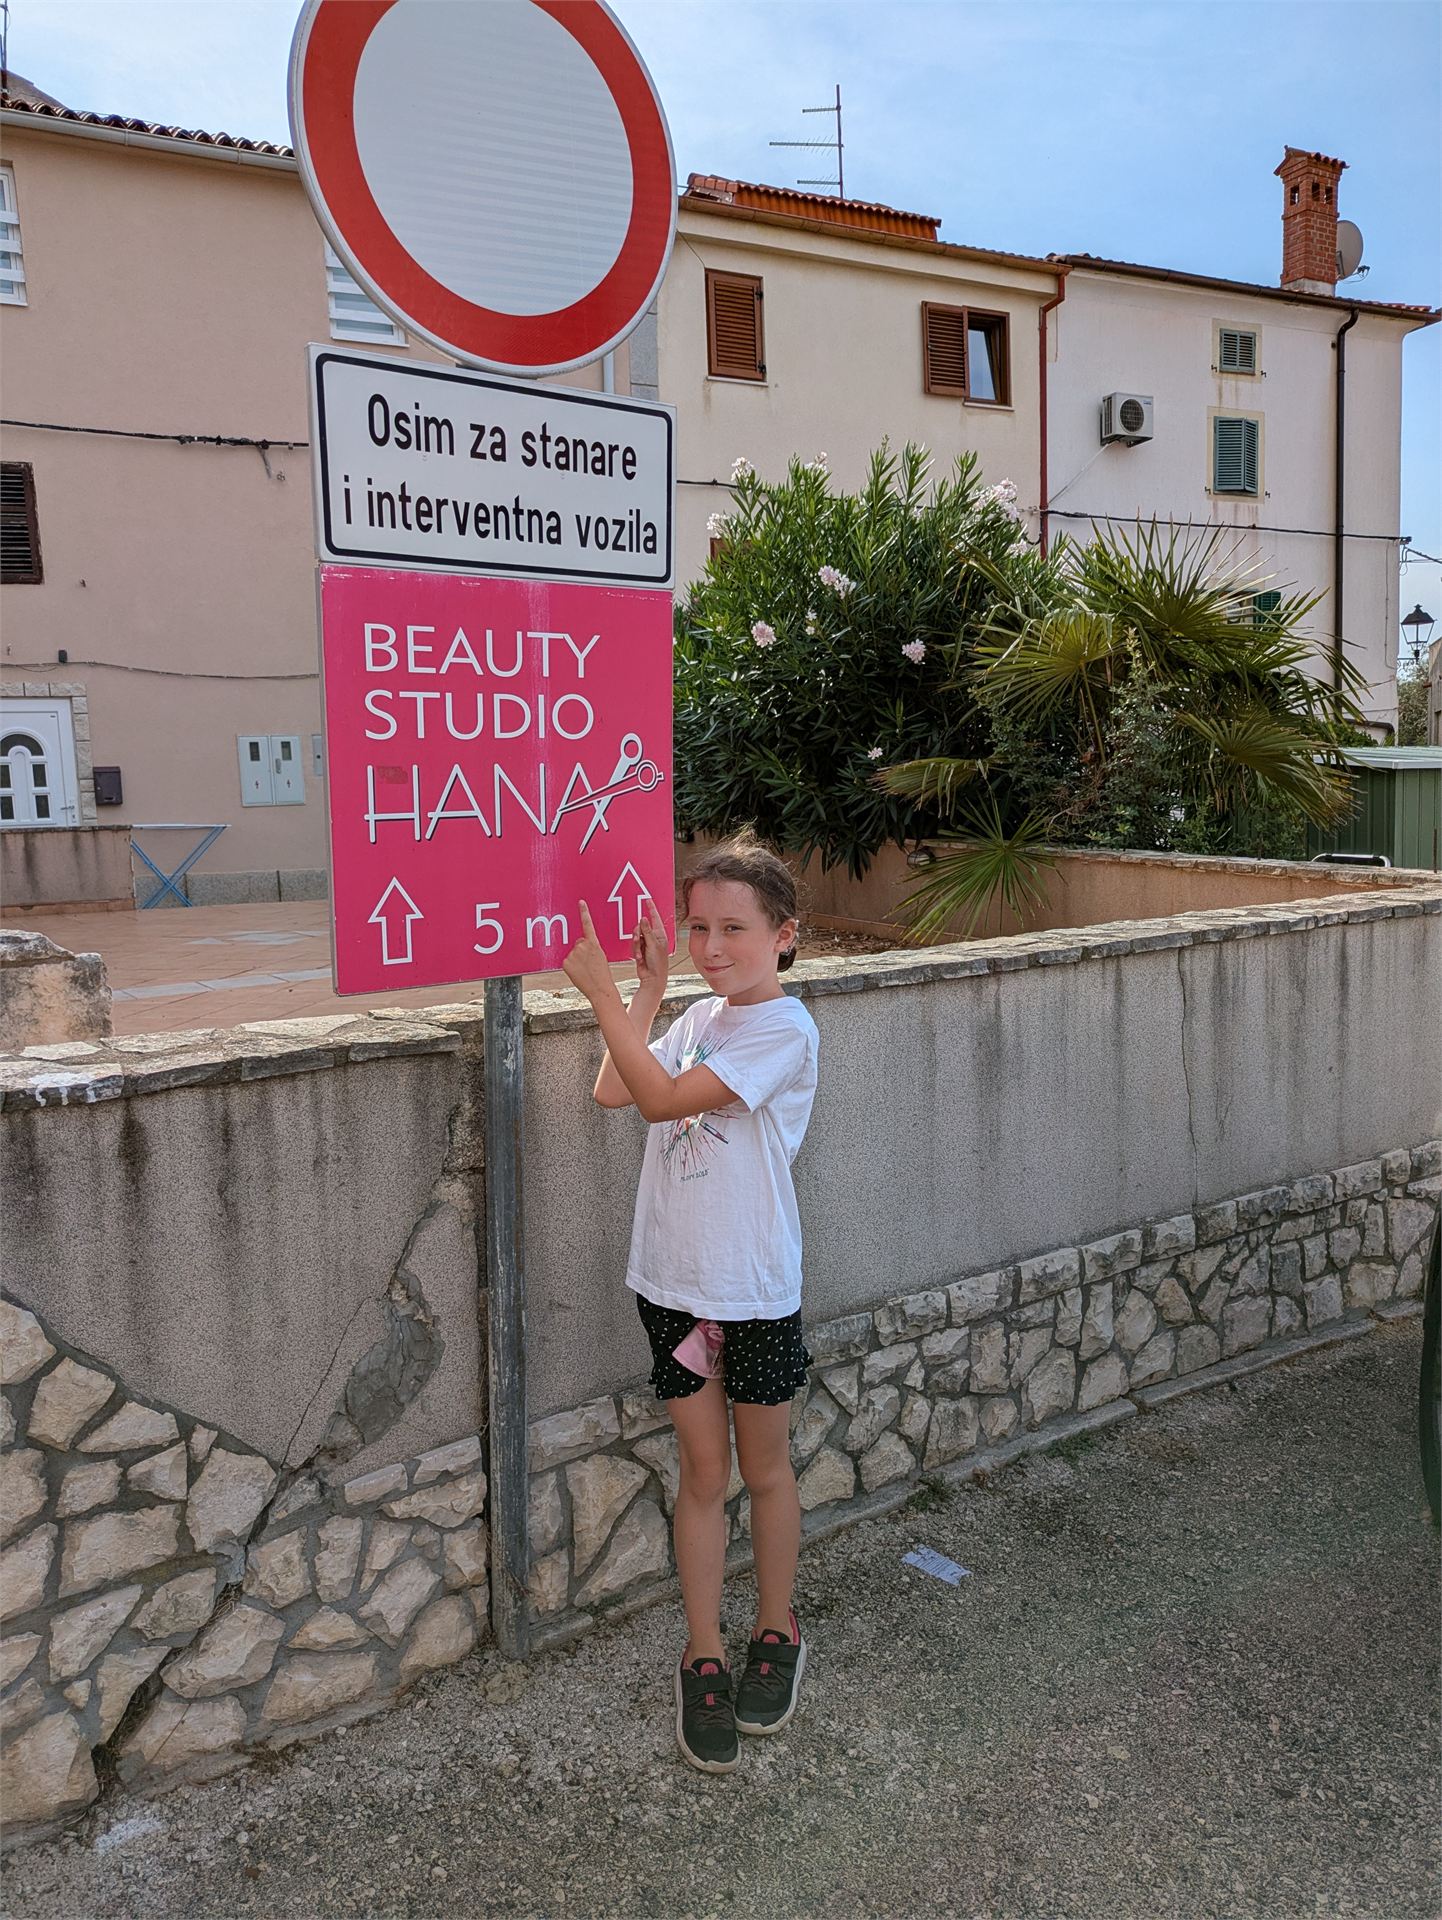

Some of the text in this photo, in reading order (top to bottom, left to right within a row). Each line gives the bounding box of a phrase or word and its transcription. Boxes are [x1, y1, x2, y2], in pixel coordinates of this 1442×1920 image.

[367, 393, 637, 481] Osim za stanare
[343, 474, 657, 555] i interventna vozila
[364, 622, 601, 680] BEAUTY
[364, 689, 595, 741] STUDIO
[364, 762, 610, 844] HANA
[474, 902, 570, 956] 5 m
